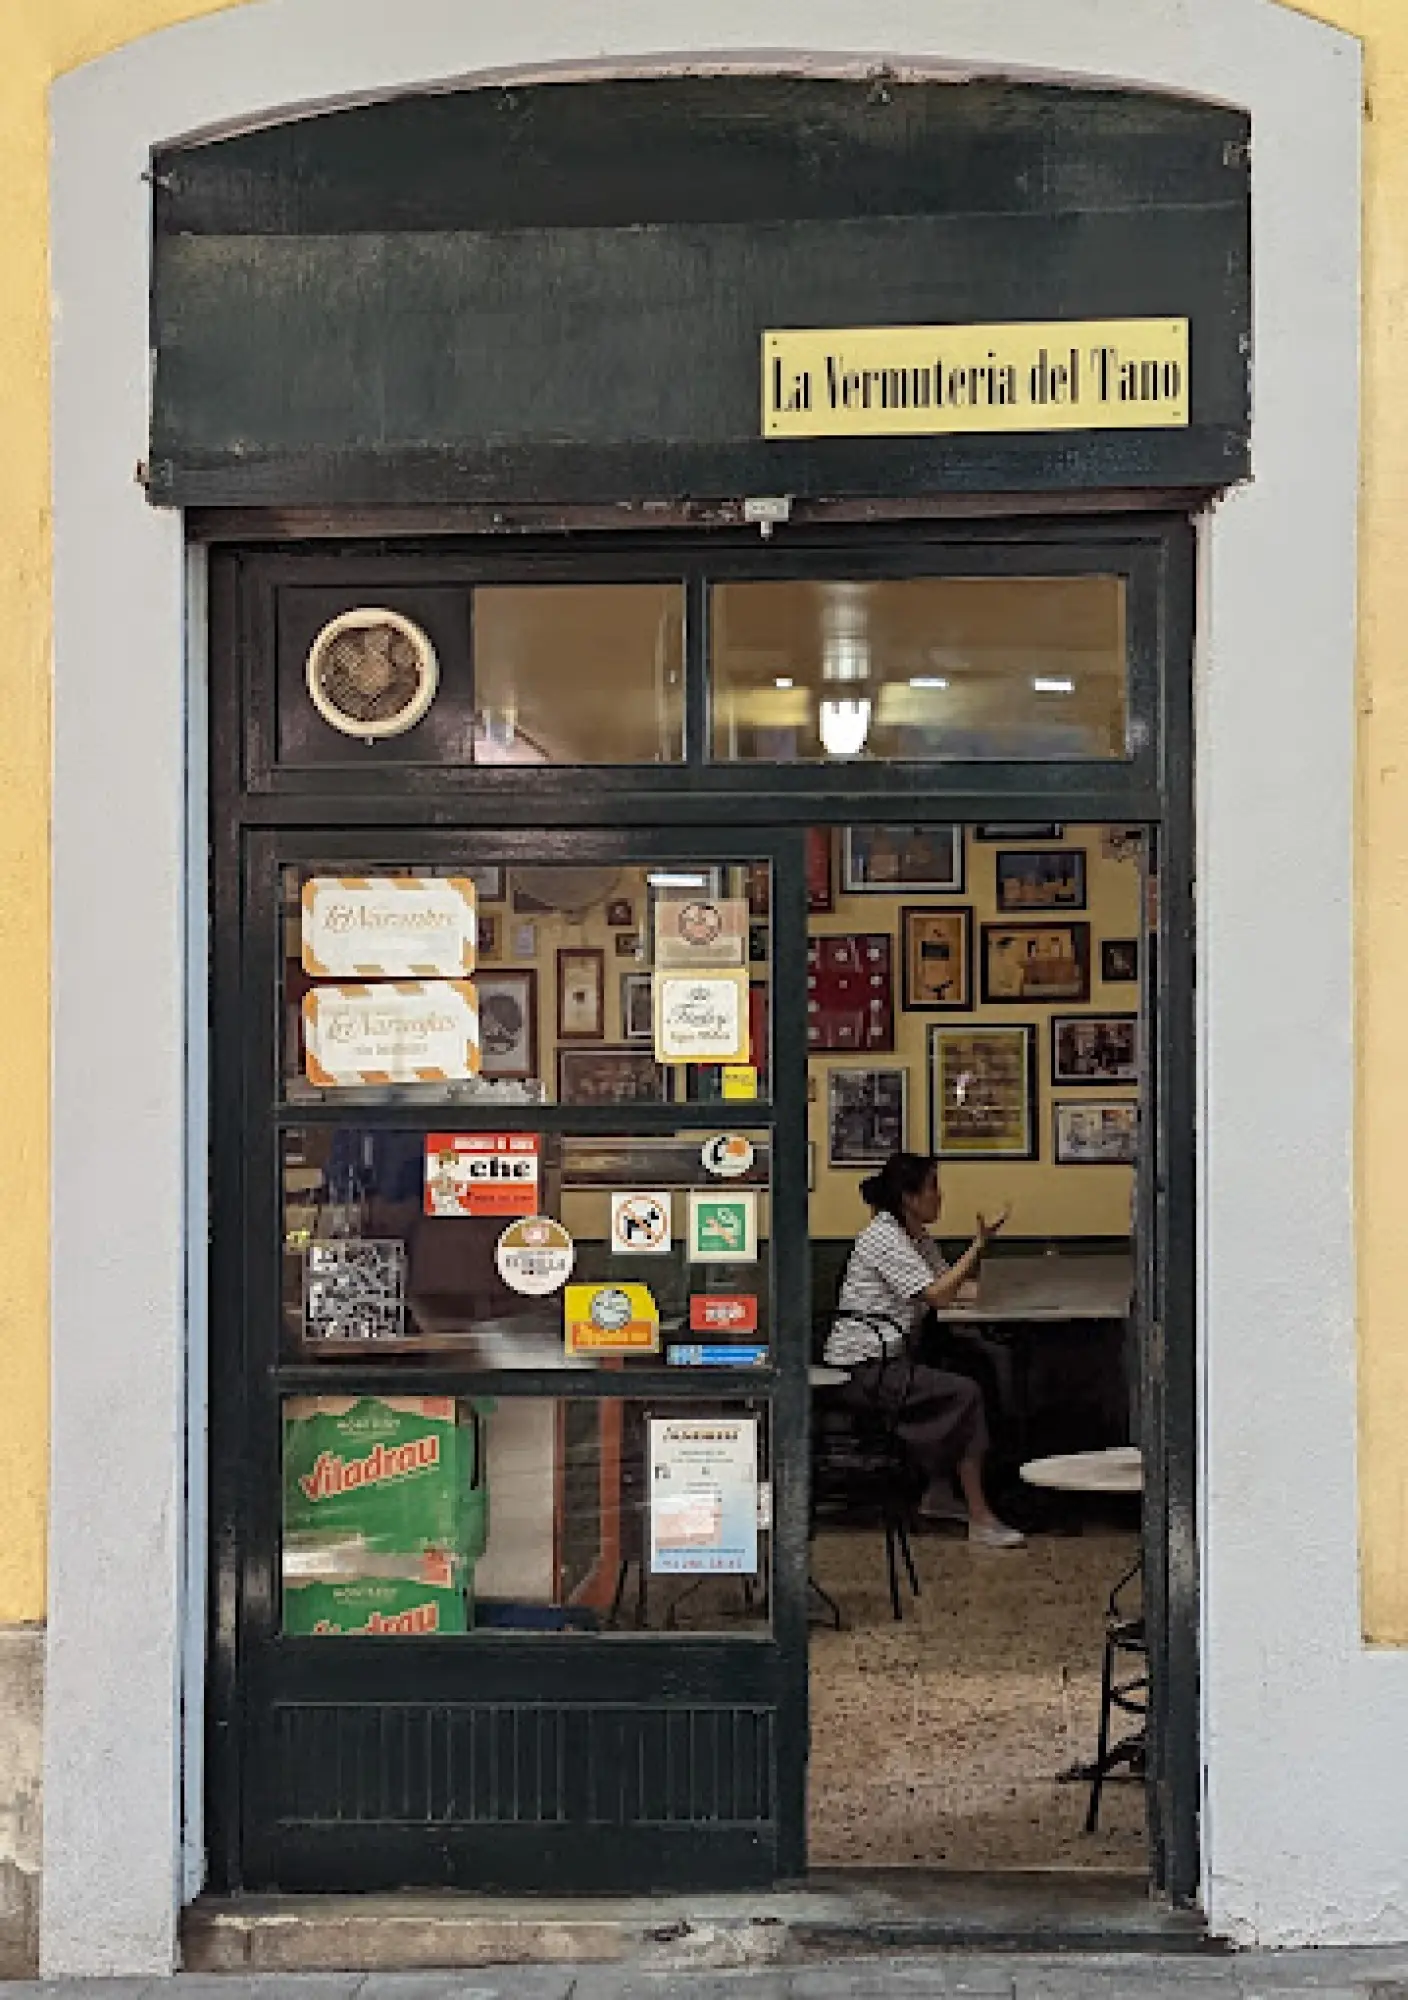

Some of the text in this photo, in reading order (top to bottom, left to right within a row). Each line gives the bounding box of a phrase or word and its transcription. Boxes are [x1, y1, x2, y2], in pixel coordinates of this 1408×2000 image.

[772, 345, 1182, 412] La Vermuteria del Tano
